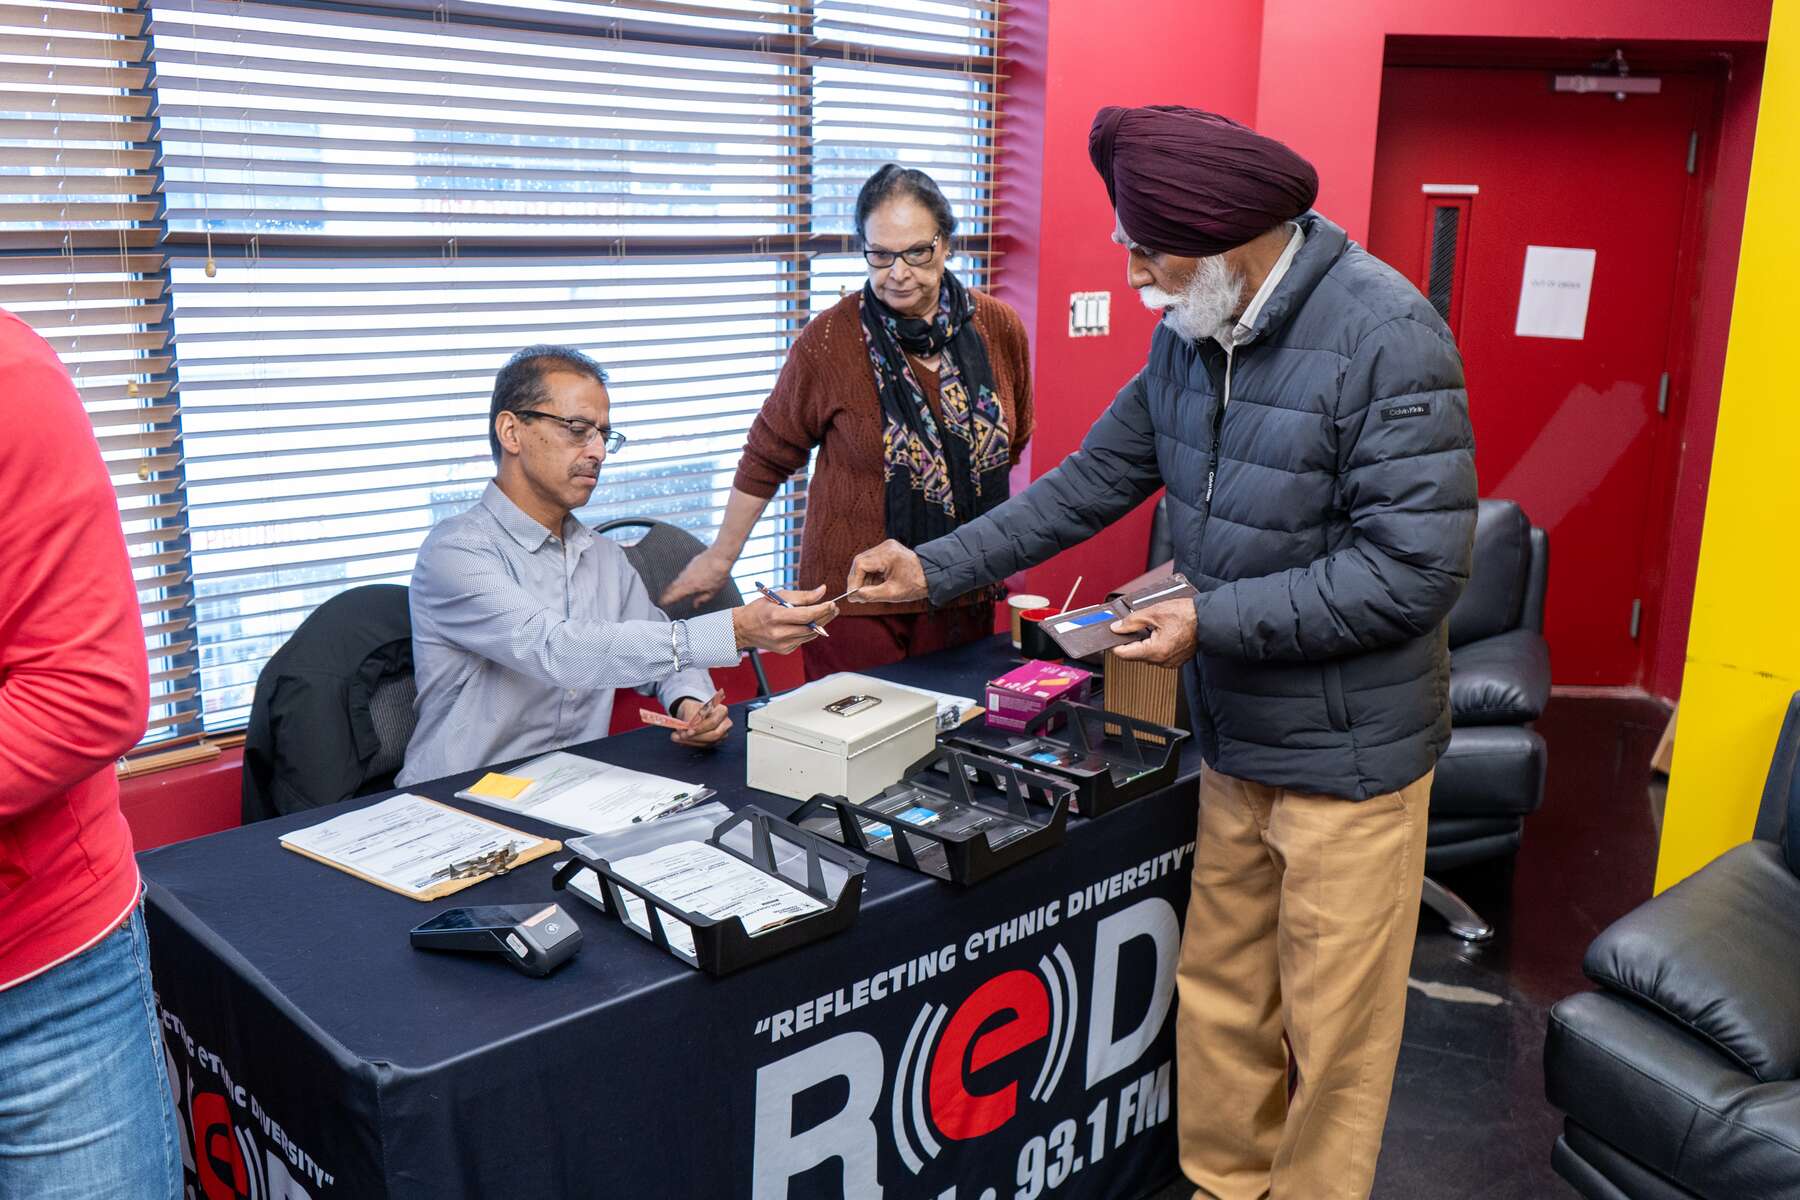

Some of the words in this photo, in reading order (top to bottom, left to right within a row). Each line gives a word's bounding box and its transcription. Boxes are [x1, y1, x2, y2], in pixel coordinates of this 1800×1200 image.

[753, 943, 957, 1043] "REFLECTING
[1066, 842, 1196, 918] DIVERSITY"
[1014, 1096, 1109, 1200] 93.1
[1115, 1060, 1170, 1149] FM
